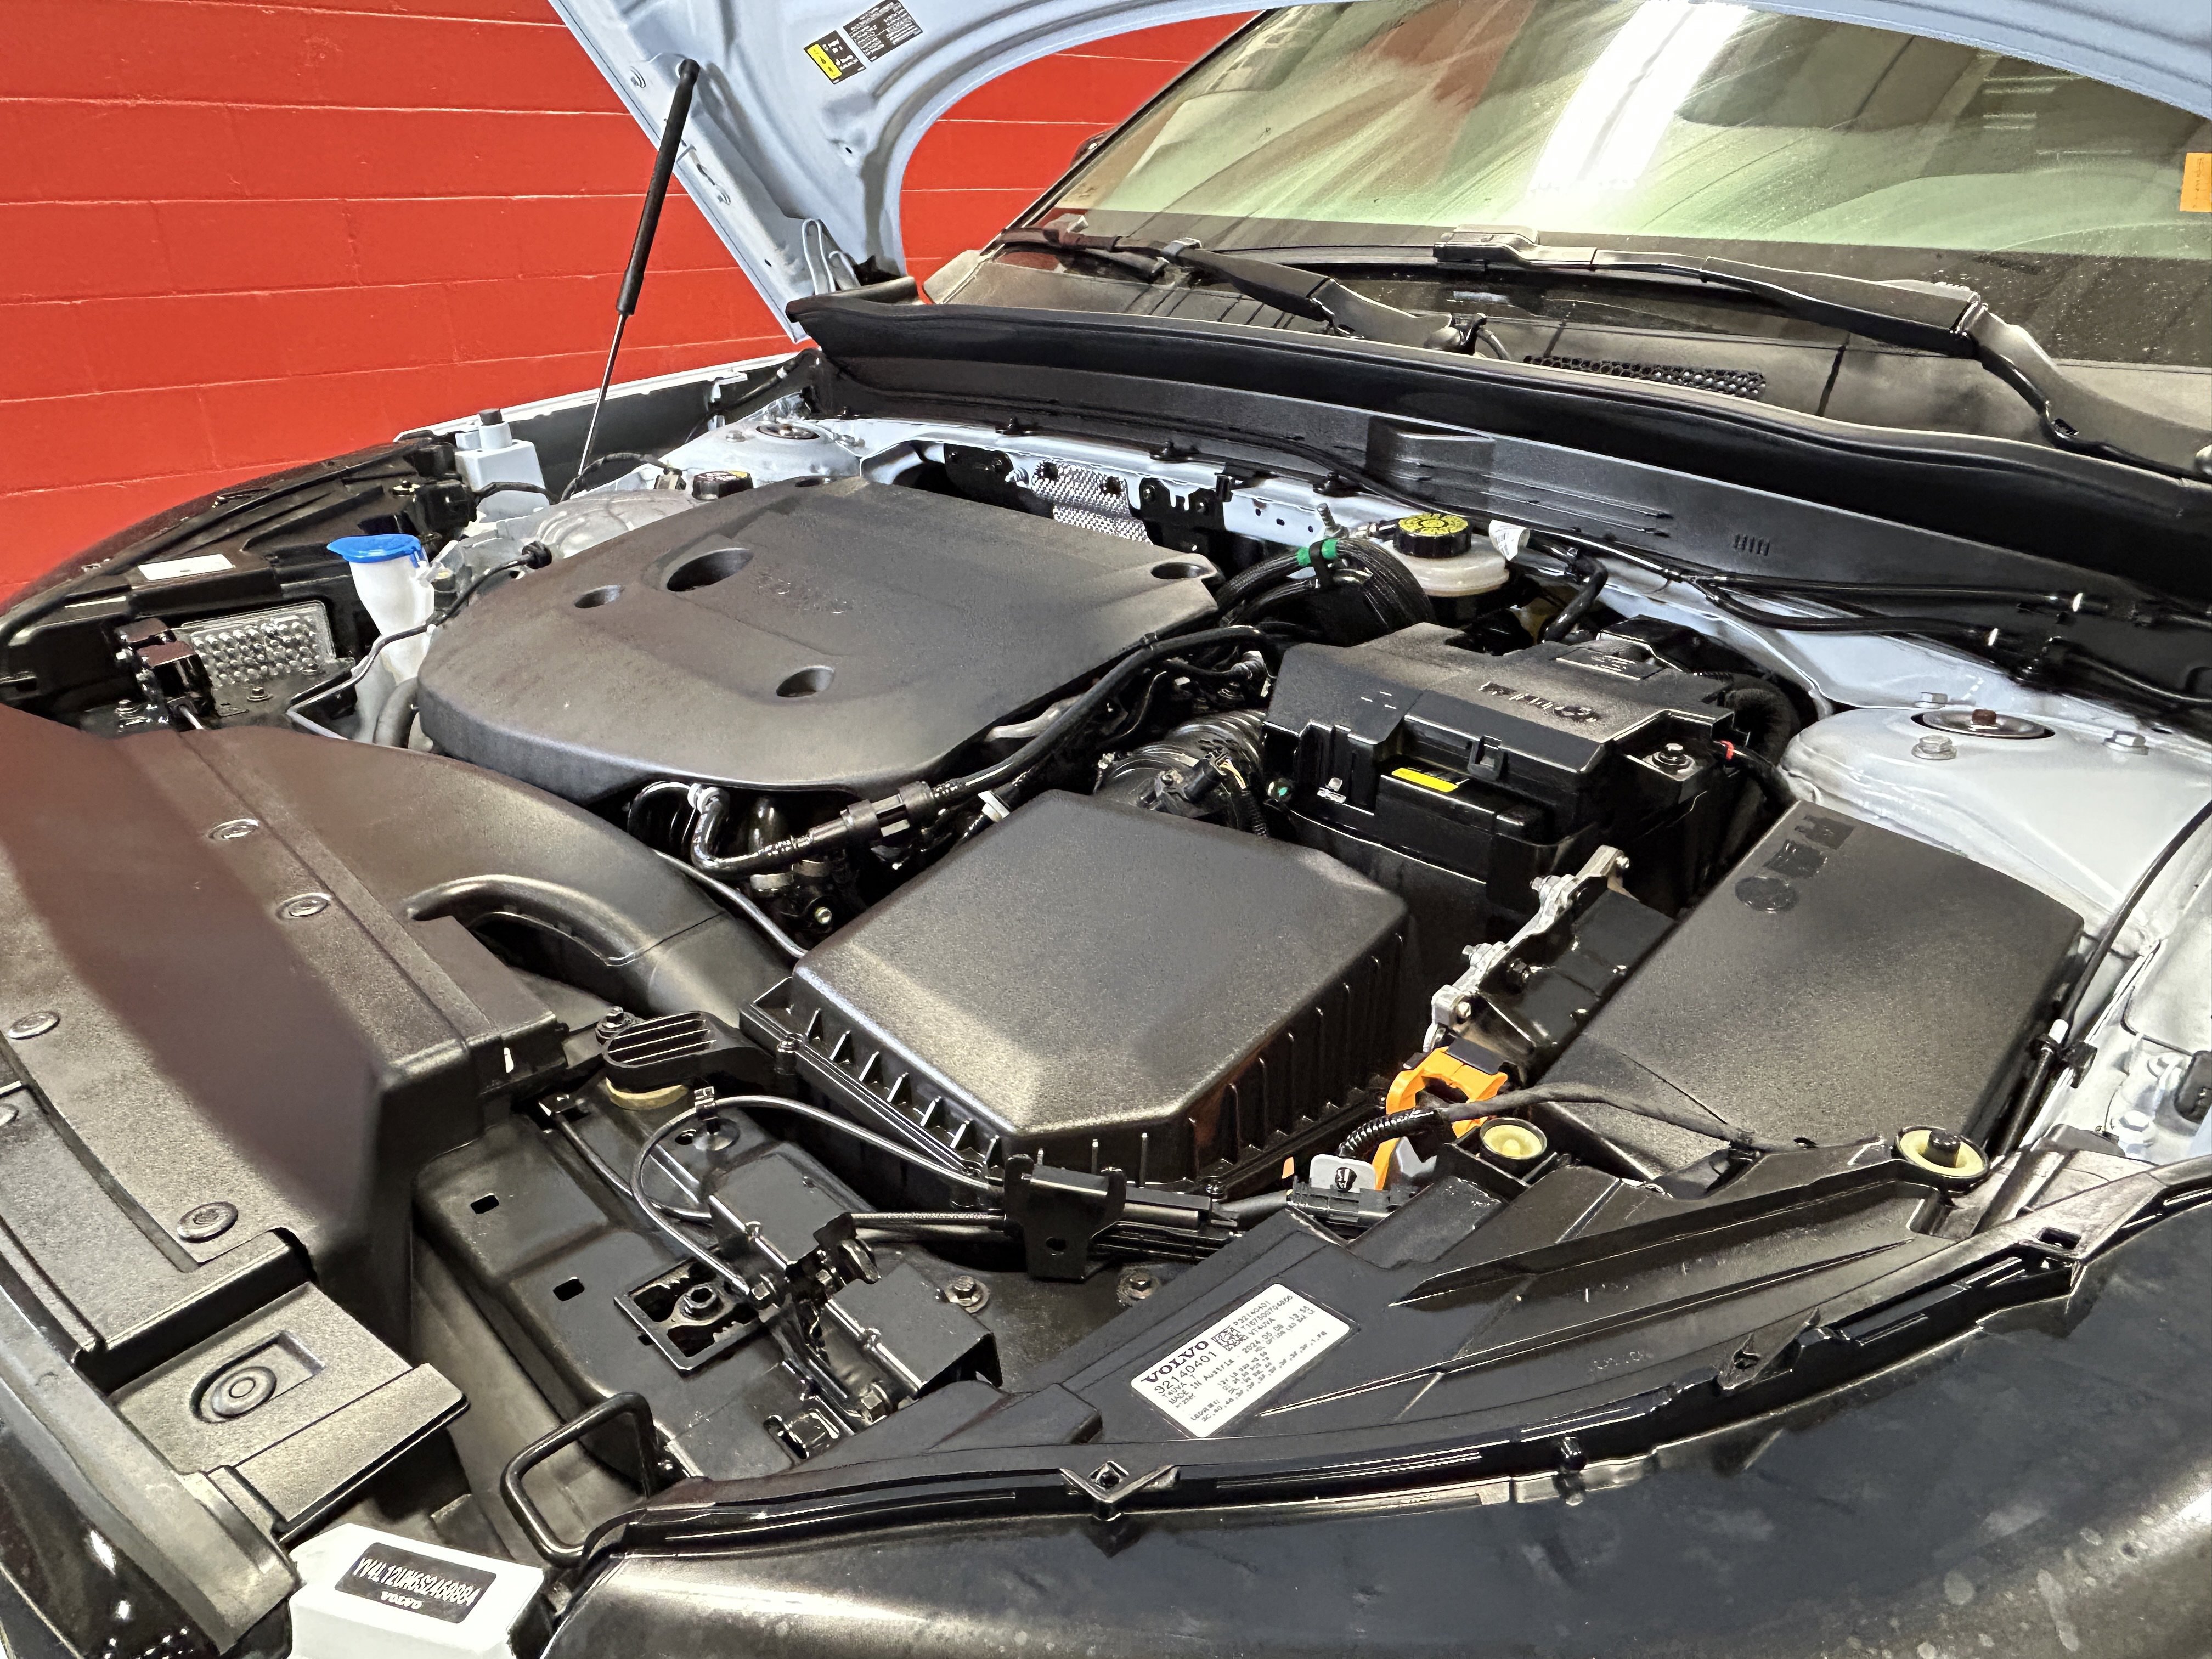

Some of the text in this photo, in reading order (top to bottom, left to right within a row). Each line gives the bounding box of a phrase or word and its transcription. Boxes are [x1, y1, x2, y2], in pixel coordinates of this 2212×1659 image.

[1141, 1340, 1209, 1384] VOLVO
[1154, 1350, 1217, 1394] 32140401
[1167, 1389, 1189, 1405] MADE
[1189, 1380, 1203, 1390] IN
[1203, 1359, 1235, 1382] Austria
[381, 1591, 423, 1609] VOLVO
